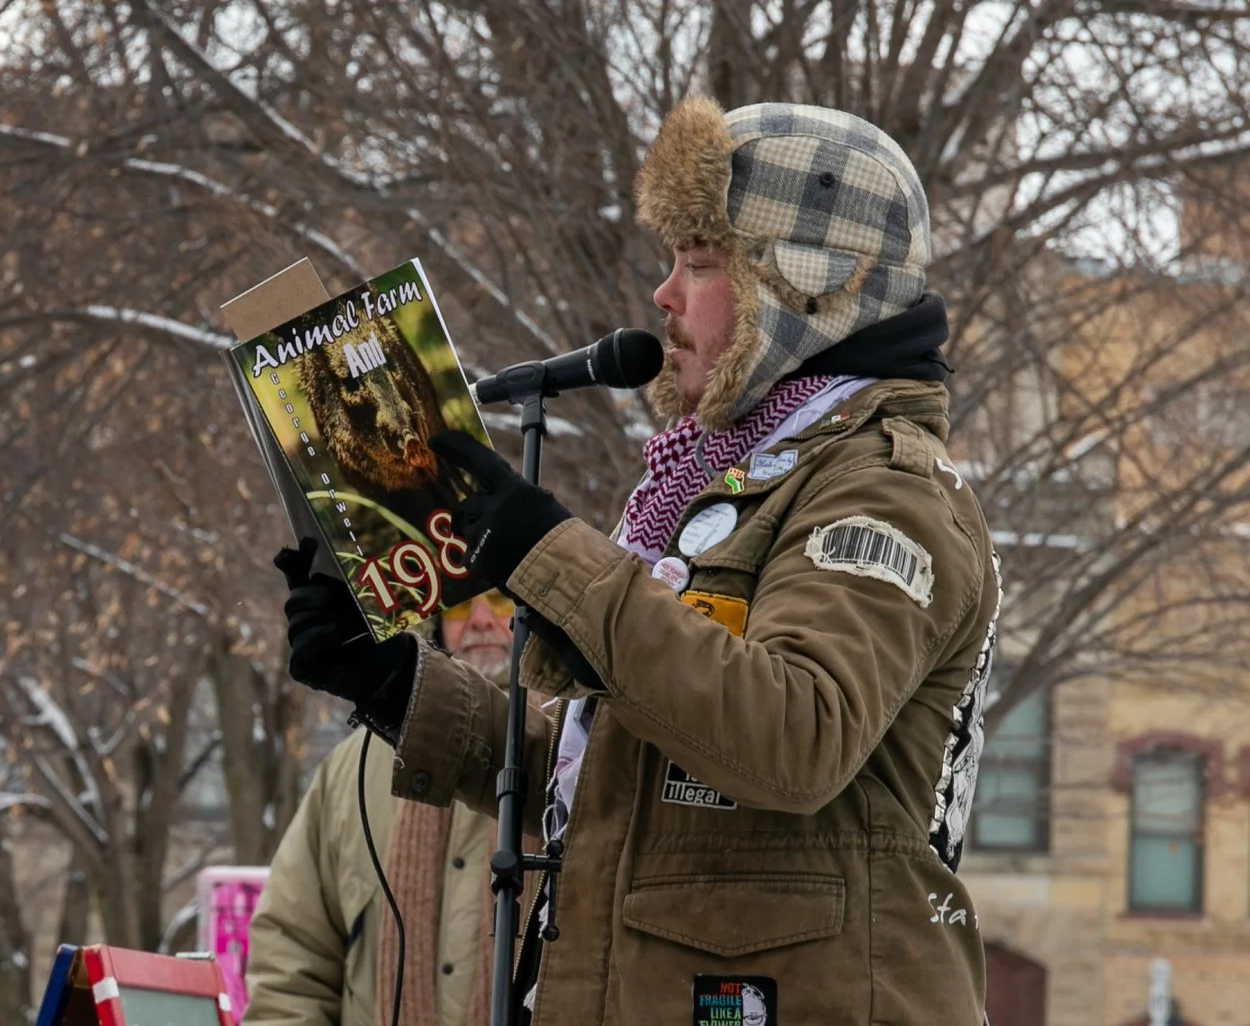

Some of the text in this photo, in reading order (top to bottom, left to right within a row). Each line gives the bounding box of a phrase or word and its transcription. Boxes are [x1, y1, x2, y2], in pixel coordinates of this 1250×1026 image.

[252, 281, 422, 378] Animal Farm
[357, 509, 470, 619] 198
[668, 781, 721, 806] illegal
[719, 982, 742, 994] NOT
[699, 995, 742, 1007] FRAGILE
[710, 1007, 742, 1019] LIKE A
